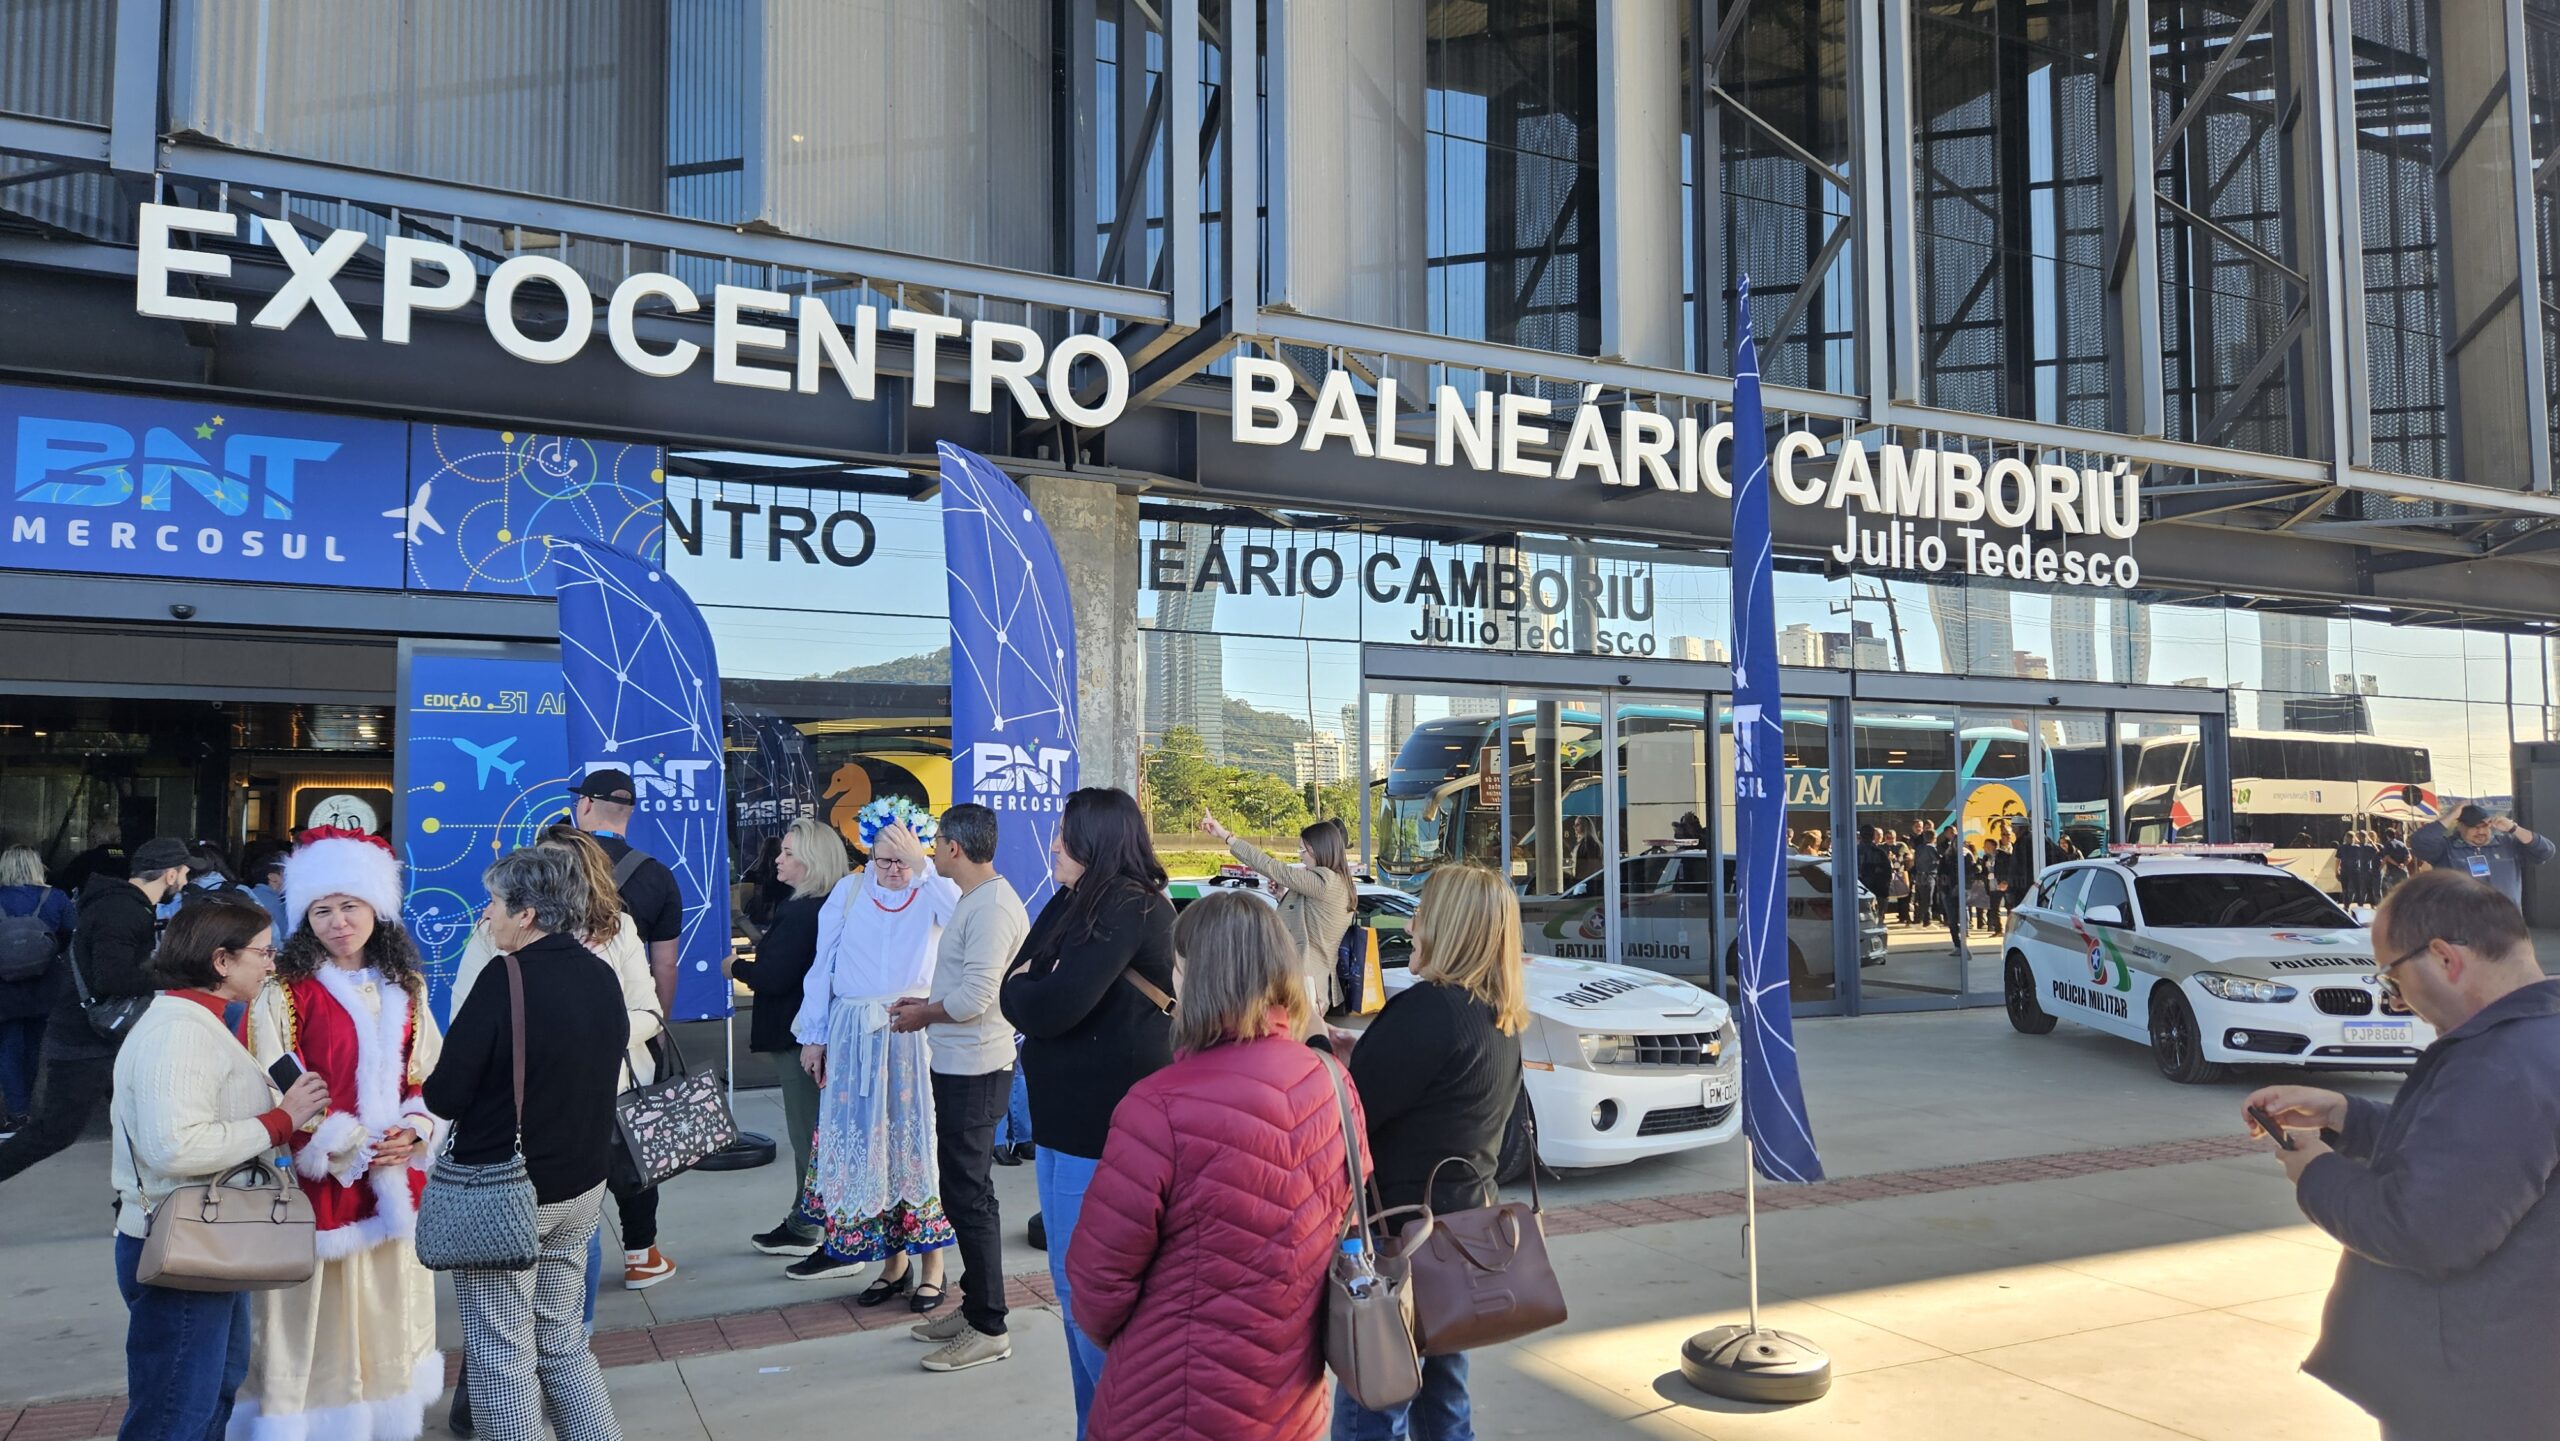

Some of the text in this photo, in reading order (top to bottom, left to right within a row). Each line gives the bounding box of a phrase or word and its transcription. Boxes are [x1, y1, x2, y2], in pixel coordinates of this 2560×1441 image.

[137, 202, 1129, 428] EXPOCENTRO
[1773, 431, 2140, 540] CAMBORIÚ
[14, 417, 343, 521] BNT
[12, 516, 346, 562] MERCOSUL
[1832, 516, 2140, 589] Julio Tedesco
[1411, 609, 1656, 656] Julio Tedsco
[423, 693, 482, 709] EDIÇÃO
[973, 742, 1073, 795] BNT
[973, 794, 1066, 813] MERCOSU
[2269, 957, 2350, 970] POLÍCIA
[1552, 978, 1640, 1007] POLÍCIA
[2052, 979, 2128, 1019] POLÍCIA MILITAR
